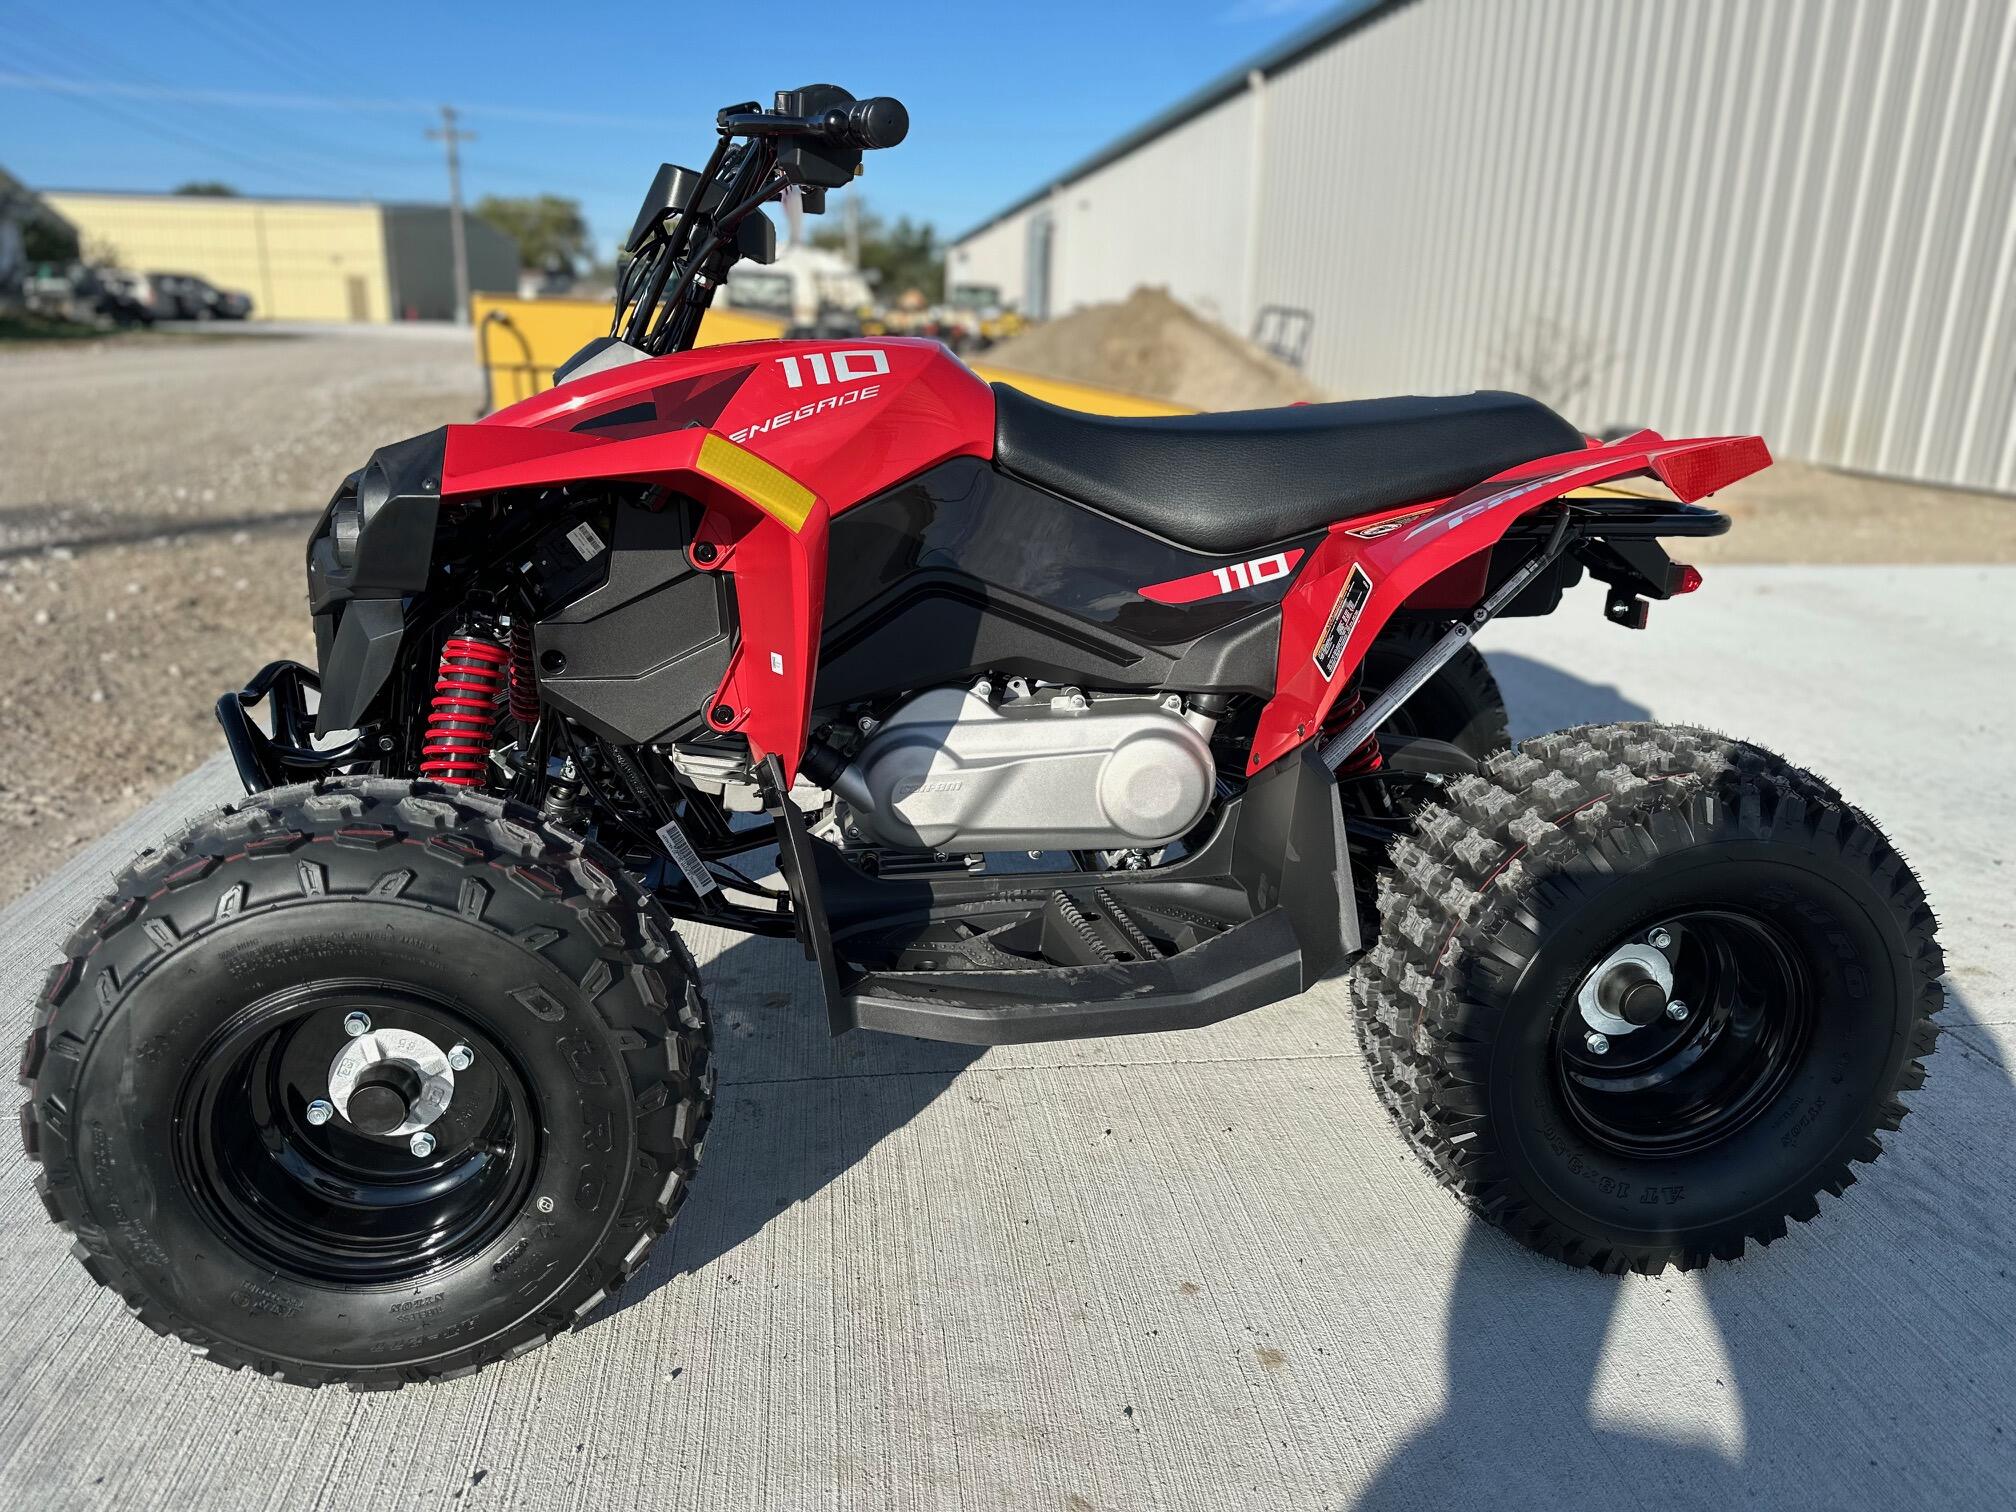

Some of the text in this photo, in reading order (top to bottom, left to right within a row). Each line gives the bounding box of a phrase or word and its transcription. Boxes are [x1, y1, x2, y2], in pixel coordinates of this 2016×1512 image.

[775, 350, 890, 388] 110
[728, 385, 880, 444] ENEGADE
[1212, 552, 1290, 594] 110
